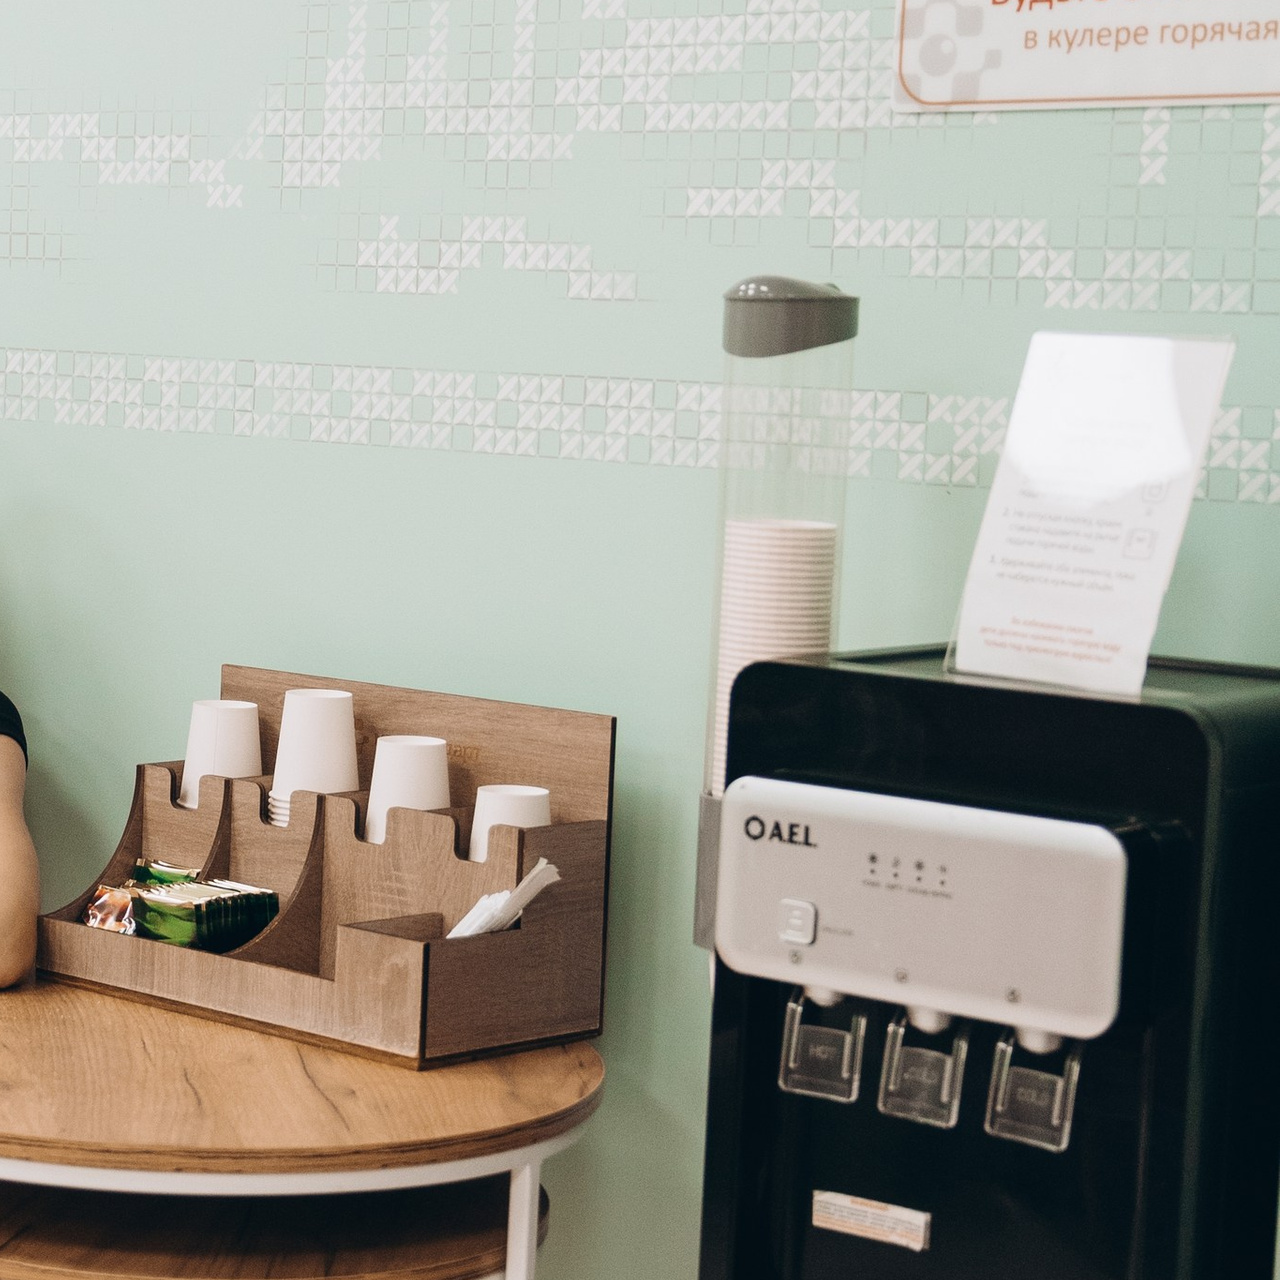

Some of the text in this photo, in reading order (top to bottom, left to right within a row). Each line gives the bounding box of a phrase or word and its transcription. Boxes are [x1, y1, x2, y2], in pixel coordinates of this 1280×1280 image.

[1023, 19, 1280, 54] в кулере горячая
